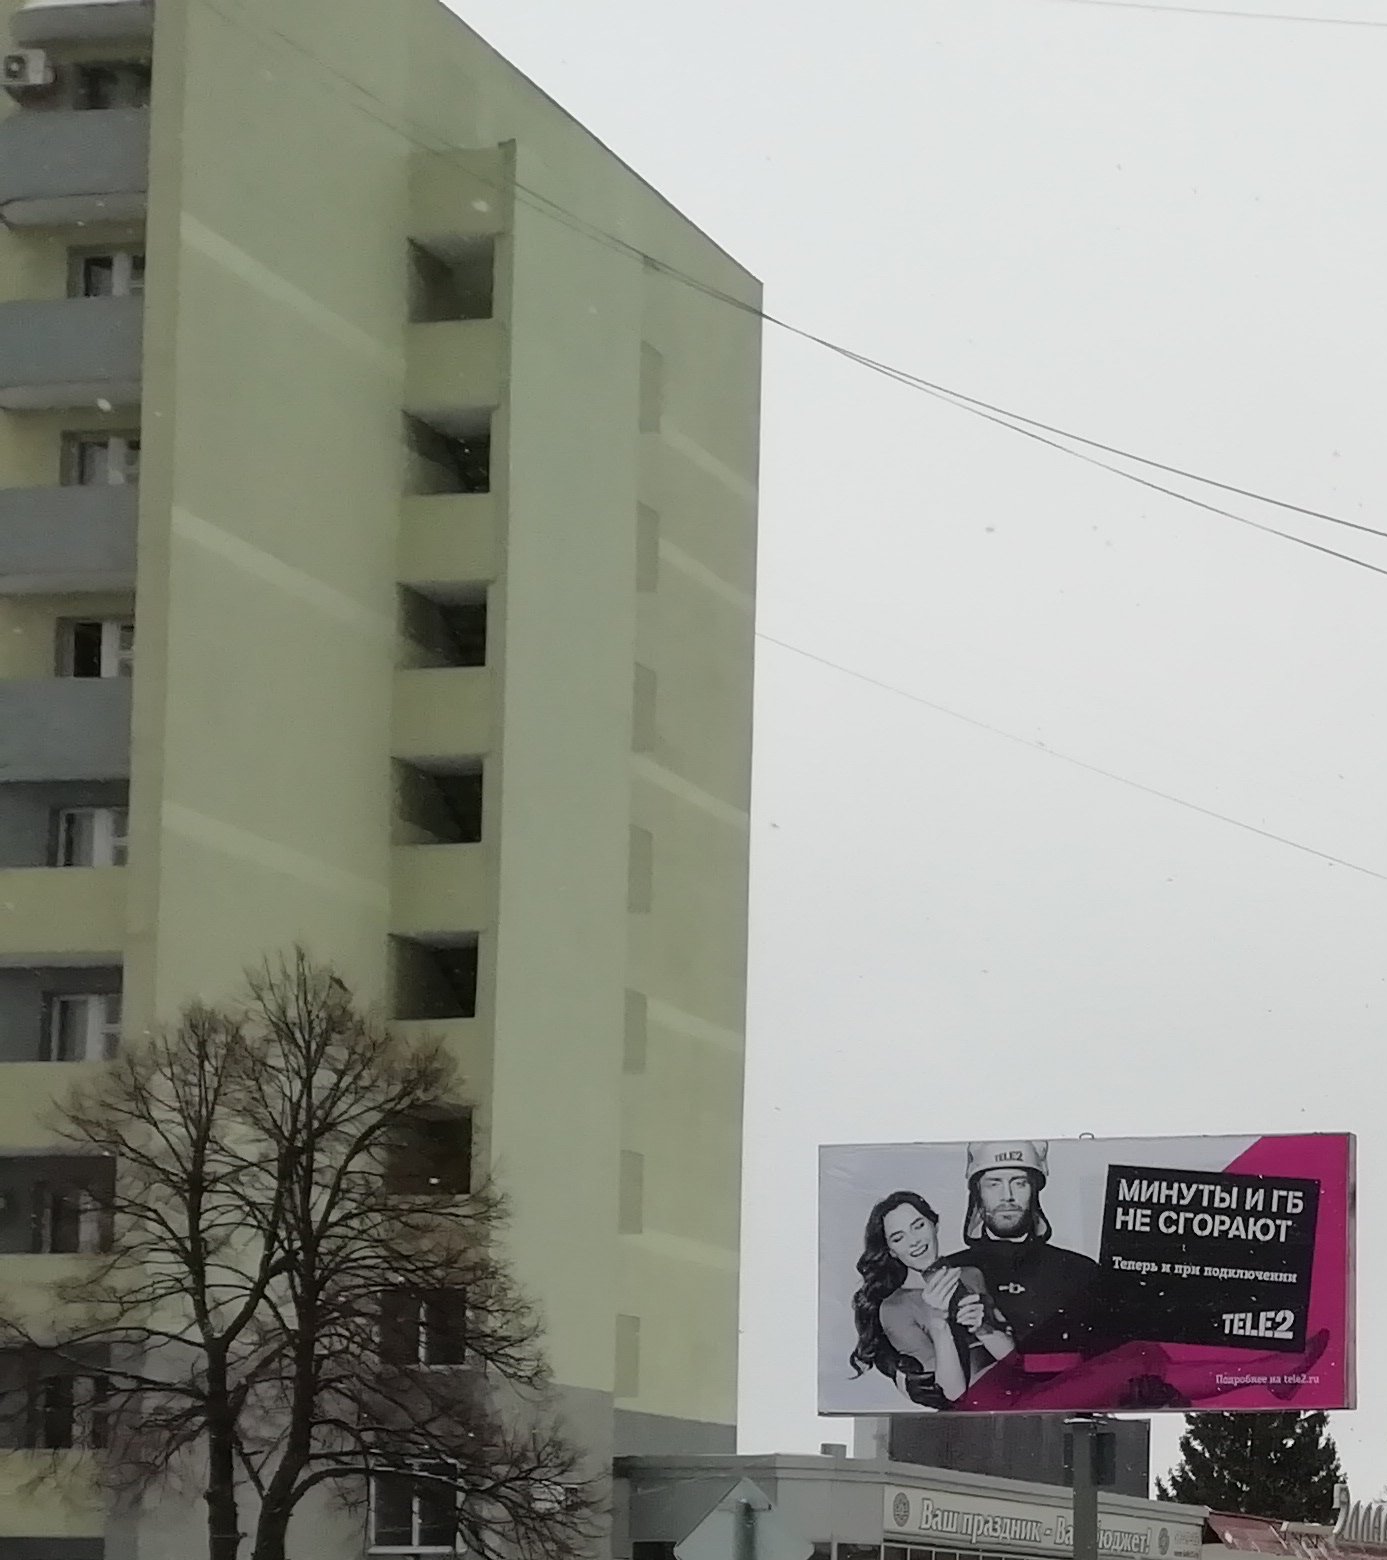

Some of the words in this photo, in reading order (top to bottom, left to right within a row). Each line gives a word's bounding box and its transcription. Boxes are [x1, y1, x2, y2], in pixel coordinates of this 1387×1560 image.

[1117, 1178, 1238, 1210] МИНУТЫ
[1244, 1187, 1265, 1212] И
[1271, 1188, 1304, 1214] ГБ
[1115, 1206, 1152, 1232] НЕ
[1158, 1210, 1293, 1243] СГОРАЮТ
[1112, 1256, 1158, 1275] Теперь
[1161, 1262, 1171, 1274] и
[1174, 1264, 1201, 1278] при
[1203, 1265, 1297, 1283] подключении
[1222, 1309, 1295, 1340] TELE2
[1215, 1374, 1267, 1387] Подробнее
[1269, 1375, 1282, 1384] на
[1284, 1373, 1320, 1385] tele2.ru
[919, 1497, 960, 1534] Ваш
[961, 1512, 1043, 1545] праздник
[1097, 1520, 1153, 1555] юджет!
